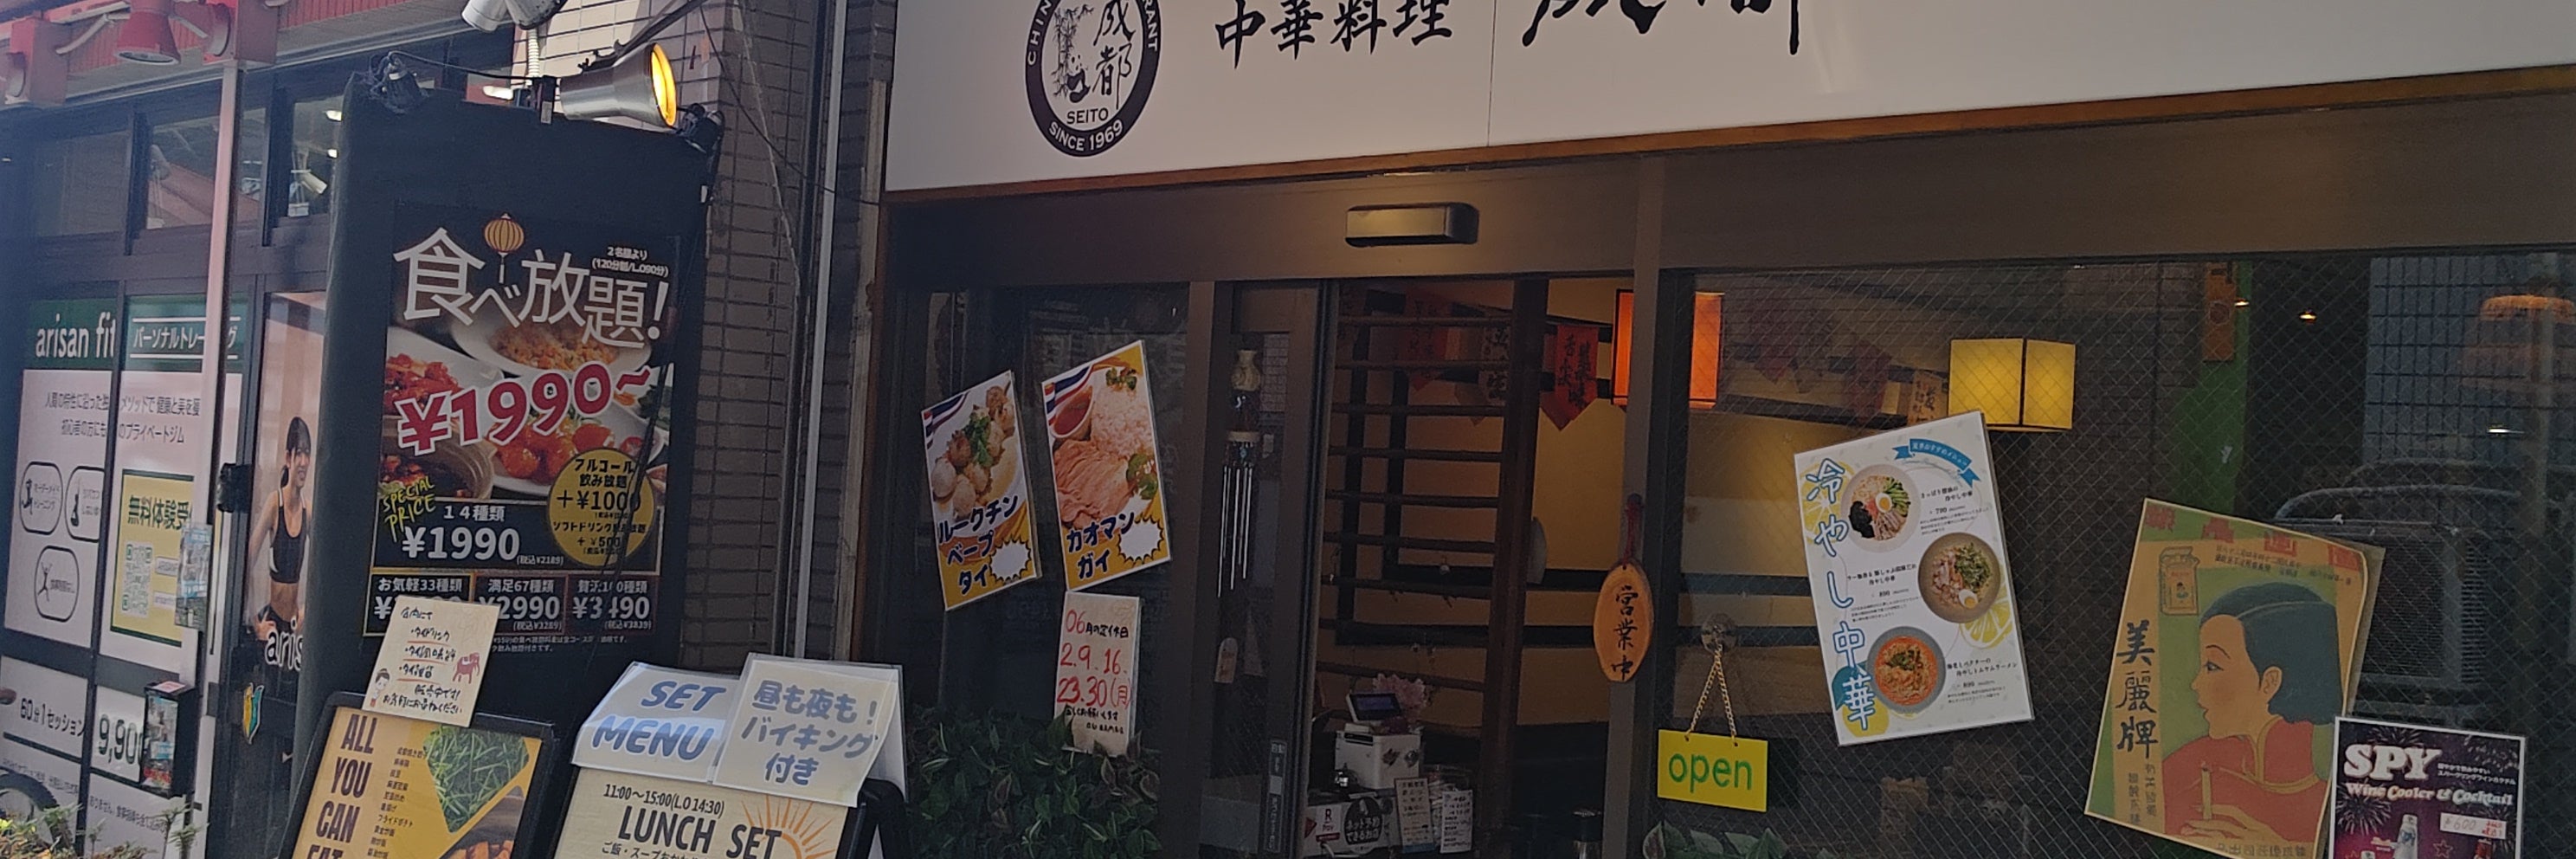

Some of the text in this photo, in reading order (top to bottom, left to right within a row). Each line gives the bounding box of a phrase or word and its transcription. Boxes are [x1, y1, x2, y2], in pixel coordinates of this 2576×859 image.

[1214, 0, 1452, 69] 中華料理
[1048, 119, 1124, 152] SINCE 1969
[1066, 108, 1109, 125] SEITO
[35, 313, 89, 358] arisan
[575, 458, 634, 474] アルコール
[579, 473, 628, 488] 飲み放題
[383, 476, 435, 513] SPECIAL
[384, 494, 436, 543] PRICE
[938, 495, 1019, 545] ルークチン
[1066, 512, 1135, 552] カオマン
[402, 526, 521, 561] ¥1990
[947, 529, 995, 565] ベープ
[959, 565, 988, 595] タイ
[1077, 549, 1111, 579] ガイ
[377, 578, 462, 593] お気軽33種類
[487, 578, 554, 594] 満足67種類
[1806, 458, 1876, 730] 冷やし中華
[1611, 585, 1639, 681] 営業中
[641, 681, 727, 712] SET
[752, 680, 877, 726] 昼も夜も!
[2115, 619, 2159, 759] 美麗牌
[341, 714, 378, 754] ALL
[592, 714, 715, 761] MENU
[741, 716, 879, 759] バイキング
[331, 756, 373, 798] YOU
[764, 752, 820, 786] 付き
[1668, 753, 1753, 793] open
[2344, 744, 2443, 781] SPY
[2386, 785, 2435, 802] Cooler
[2451, 788, 2514, 807] Cocktail
[316, 800, 361, 843] CAN
[617, 805, 782, 859] LUNCH SET
